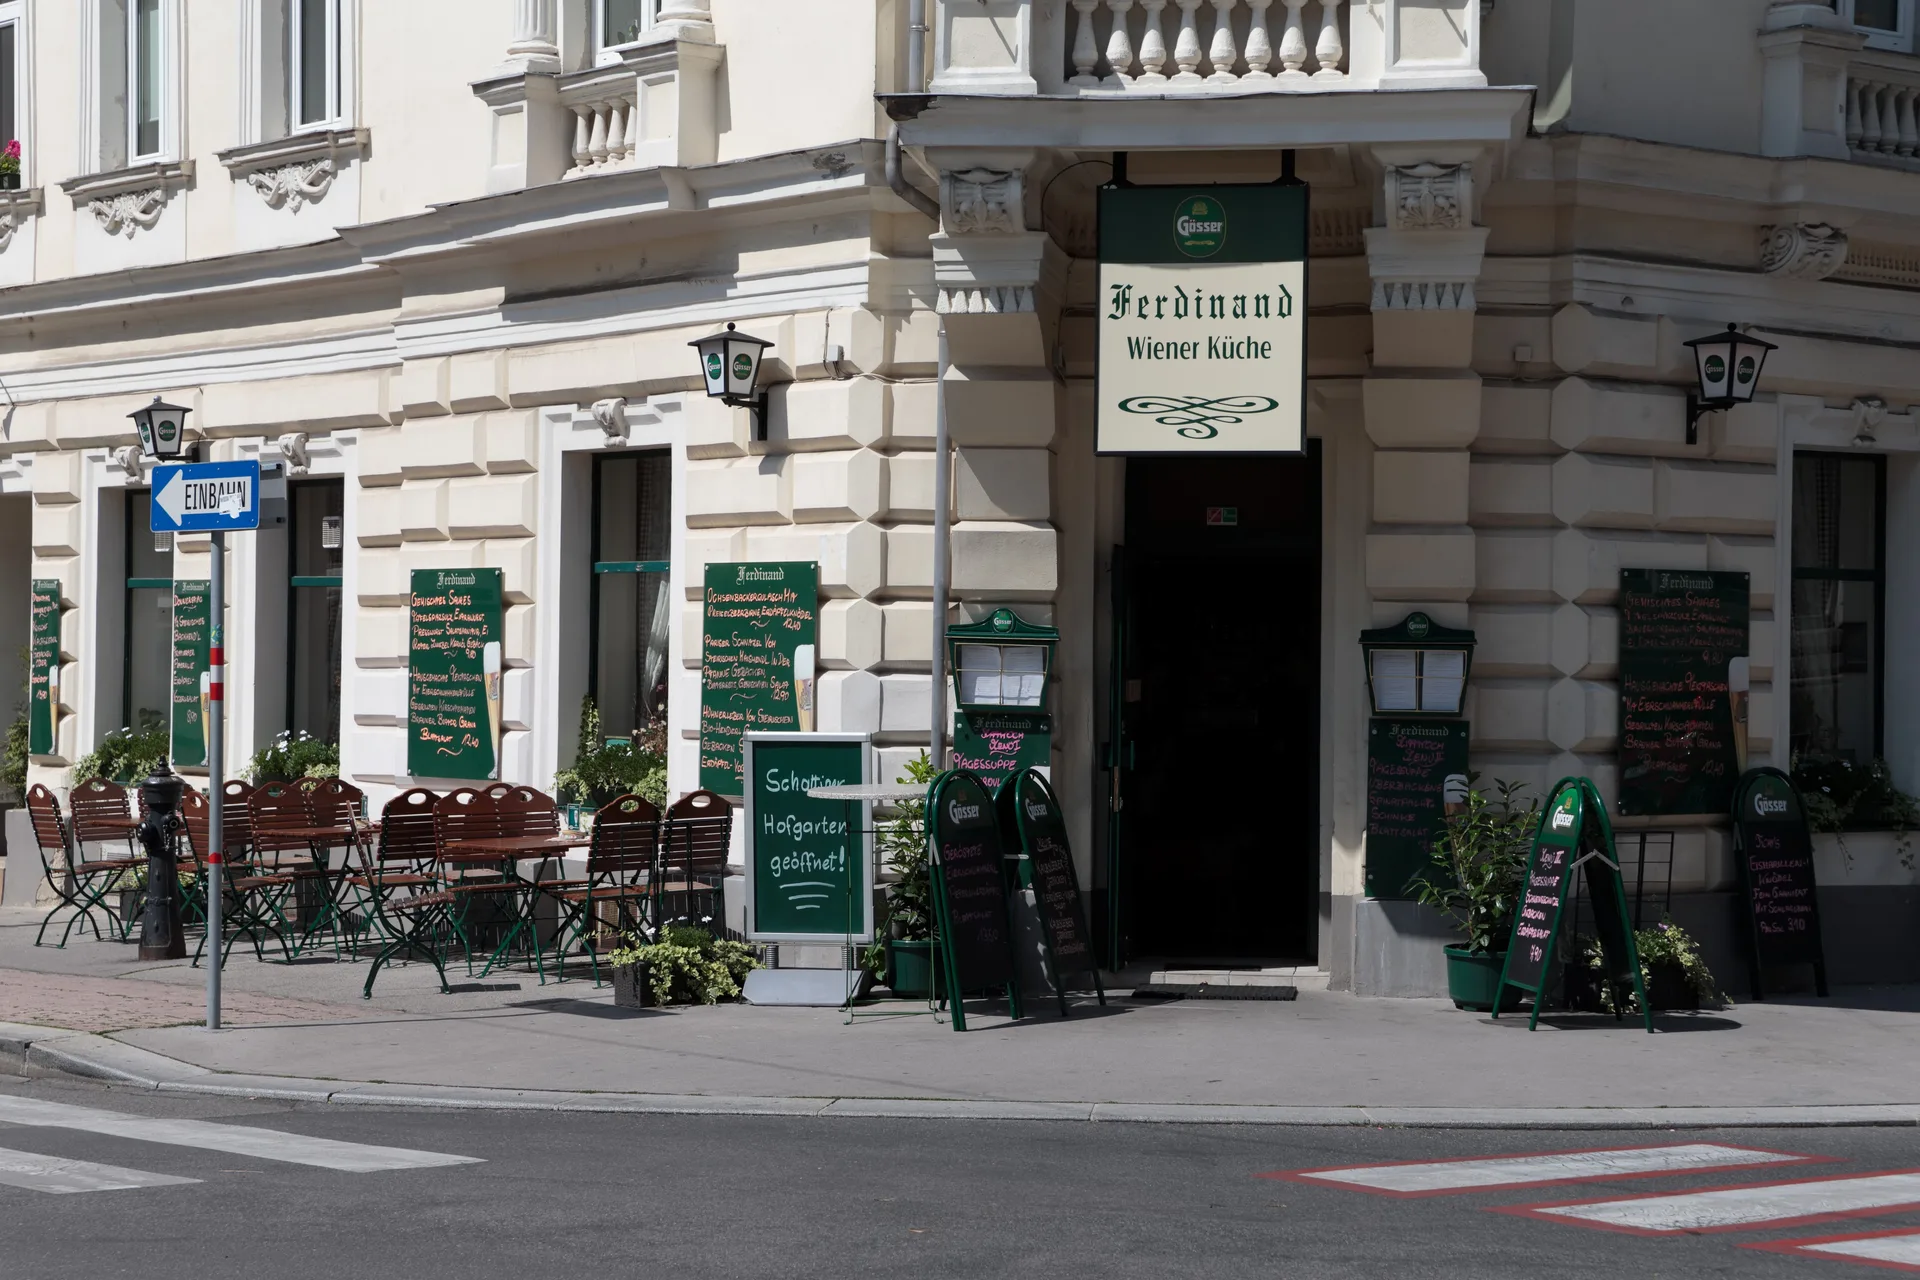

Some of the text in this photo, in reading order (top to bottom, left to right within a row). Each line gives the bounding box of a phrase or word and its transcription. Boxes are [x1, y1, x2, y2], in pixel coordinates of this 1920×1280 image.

[1176, 215, 1223, 237] Gösser
[1107, 283, 1293, 320] Ferdinand
[1127, 335, 1272, 360] Wiener Küche
[733, 361, 752, 371] Gösser
[437, 572, 476, 589] Ferdinand
[736, 566, 784, 585] Ferdinand
[1659, 573, 1715, 592] Ferdinand
[993, 617, 1012, 626] Gösser
[1408, 621, 1427, 630] Gösser
[973, 717, 1032, 732] Ferdinand
[1388, 724, 1449, 738] Ferdinand
[953, 753, 1017, 771] TAGESSUPPE
[949, 799, 979, 824] Gösser
[1025, 798, 1048, 822] Gösser
[1754, 792, 1788, 816] Gösser
[764, 813, 848, 841] Hofgarten
[1552, 805, 1574, 830] Gösser
[770, 845, 845, 877] geöffnet!
